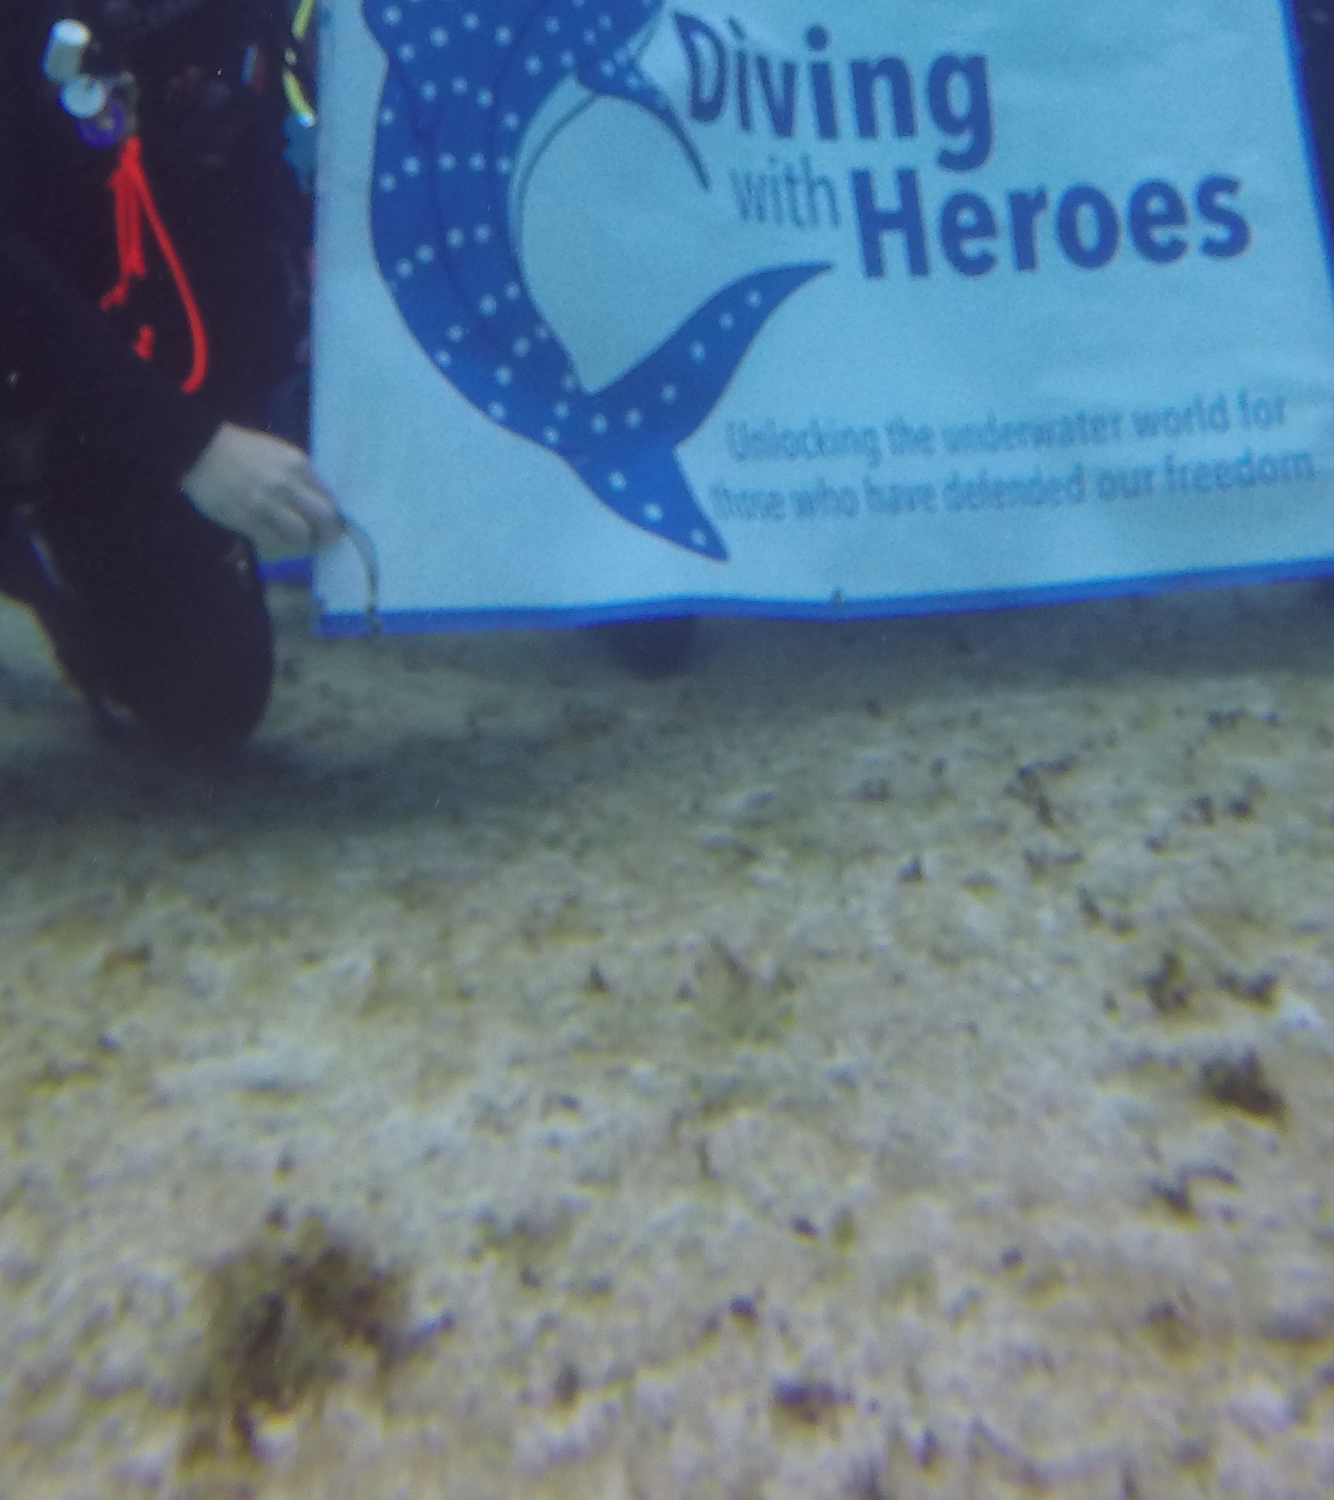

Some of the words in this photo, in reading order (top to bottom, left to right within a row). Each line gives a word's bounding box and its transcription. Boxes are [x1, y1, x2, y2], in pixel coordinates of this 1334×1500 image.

[673, 11, 993, 172] Diving
[729, 154, 841, 229] with
[850, 167, 1251, 278] Heroes
[725, 417, 883, 466] Unlocking
[885, 415, 935, 453] the
[941, 410, 1122, 453] underwater
[1130, 392, 1230, 437] world
[1237, 386, 1287, 429] for
[708, 478, 785, 522] those
[788, 477, 860, 518] who
[862, 474, 937, 514] have
[942, 462, 1086, 514] defended
[1097, 466, 1155, 500] our
